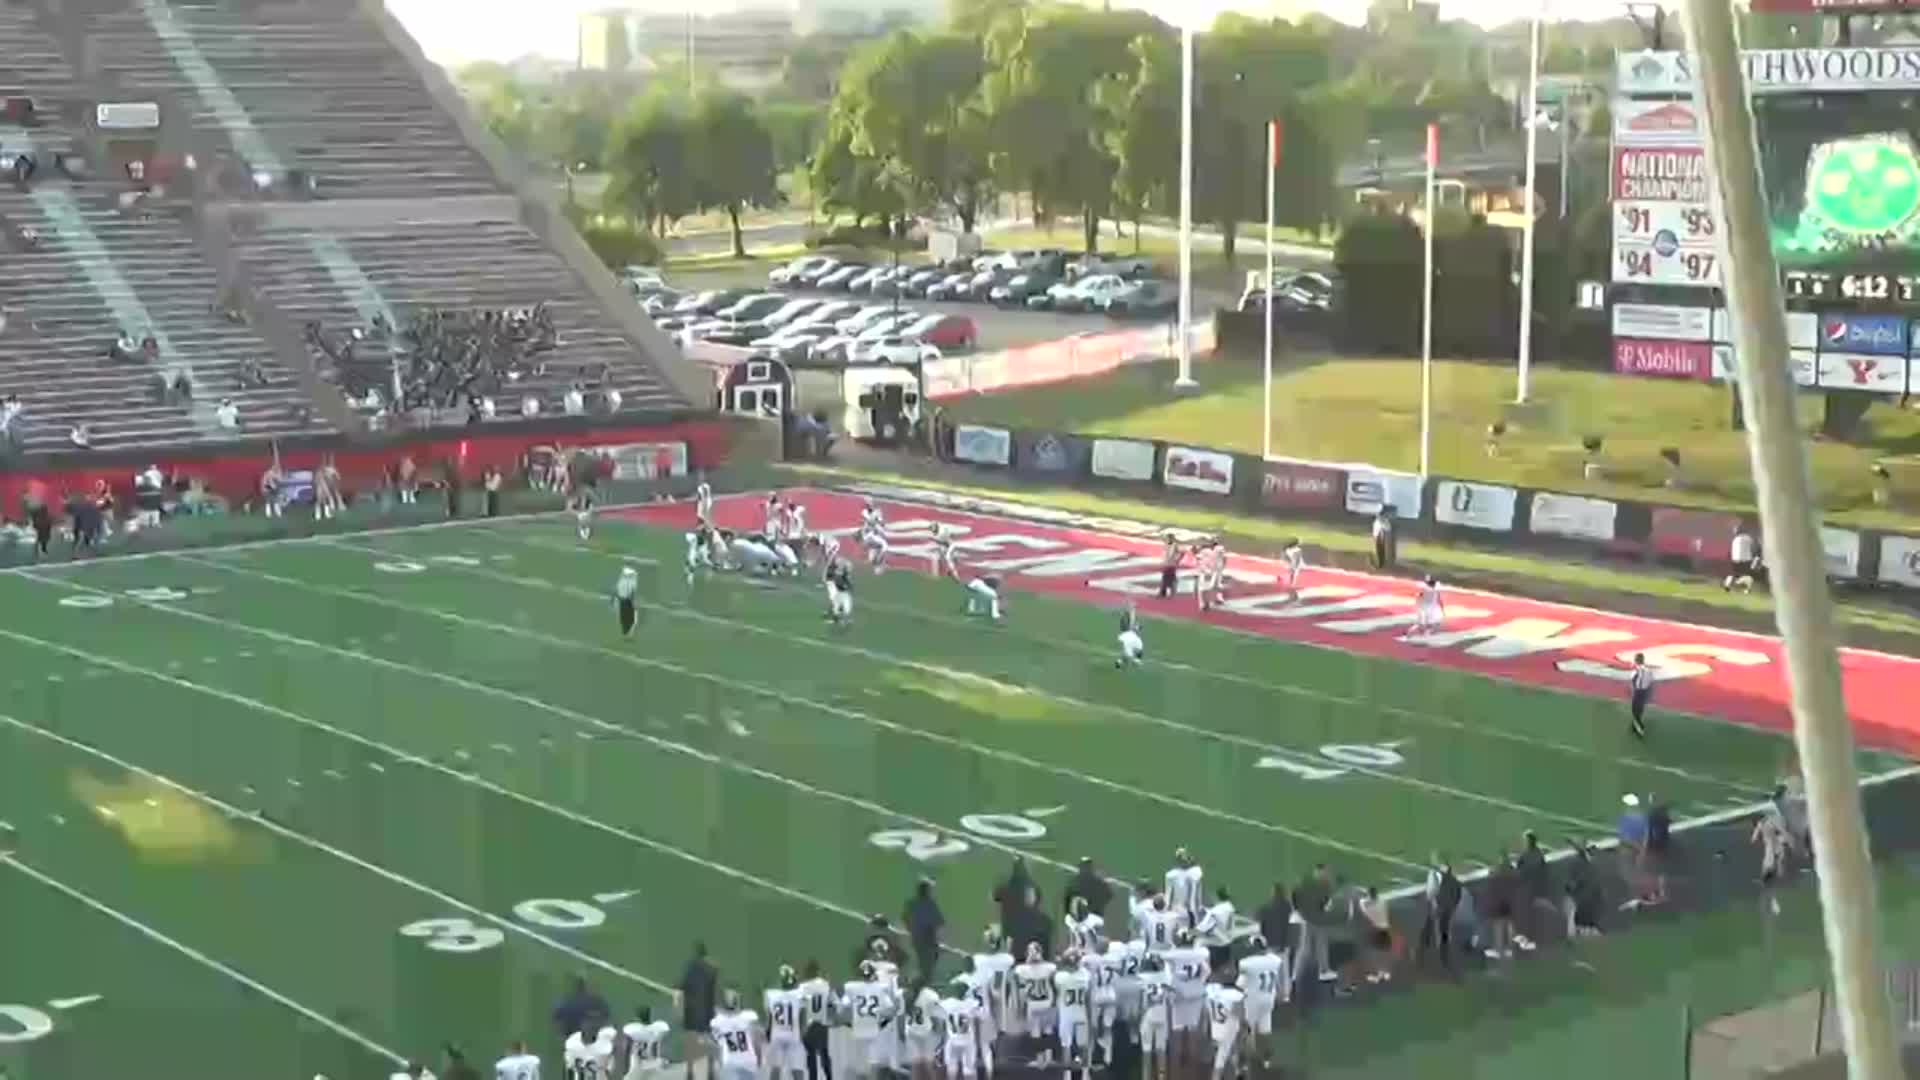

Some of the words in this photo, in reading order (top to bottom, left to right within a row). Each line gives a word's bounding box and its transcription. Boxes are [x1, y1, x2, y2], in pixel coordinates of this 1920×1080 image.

[1621, 152, 1705, 178] NATIONA
[1620, 250, 1651, 276] '94
[1680, 253, 1714, 279] '97
[1841, 274, 1888, 298] 6:12
